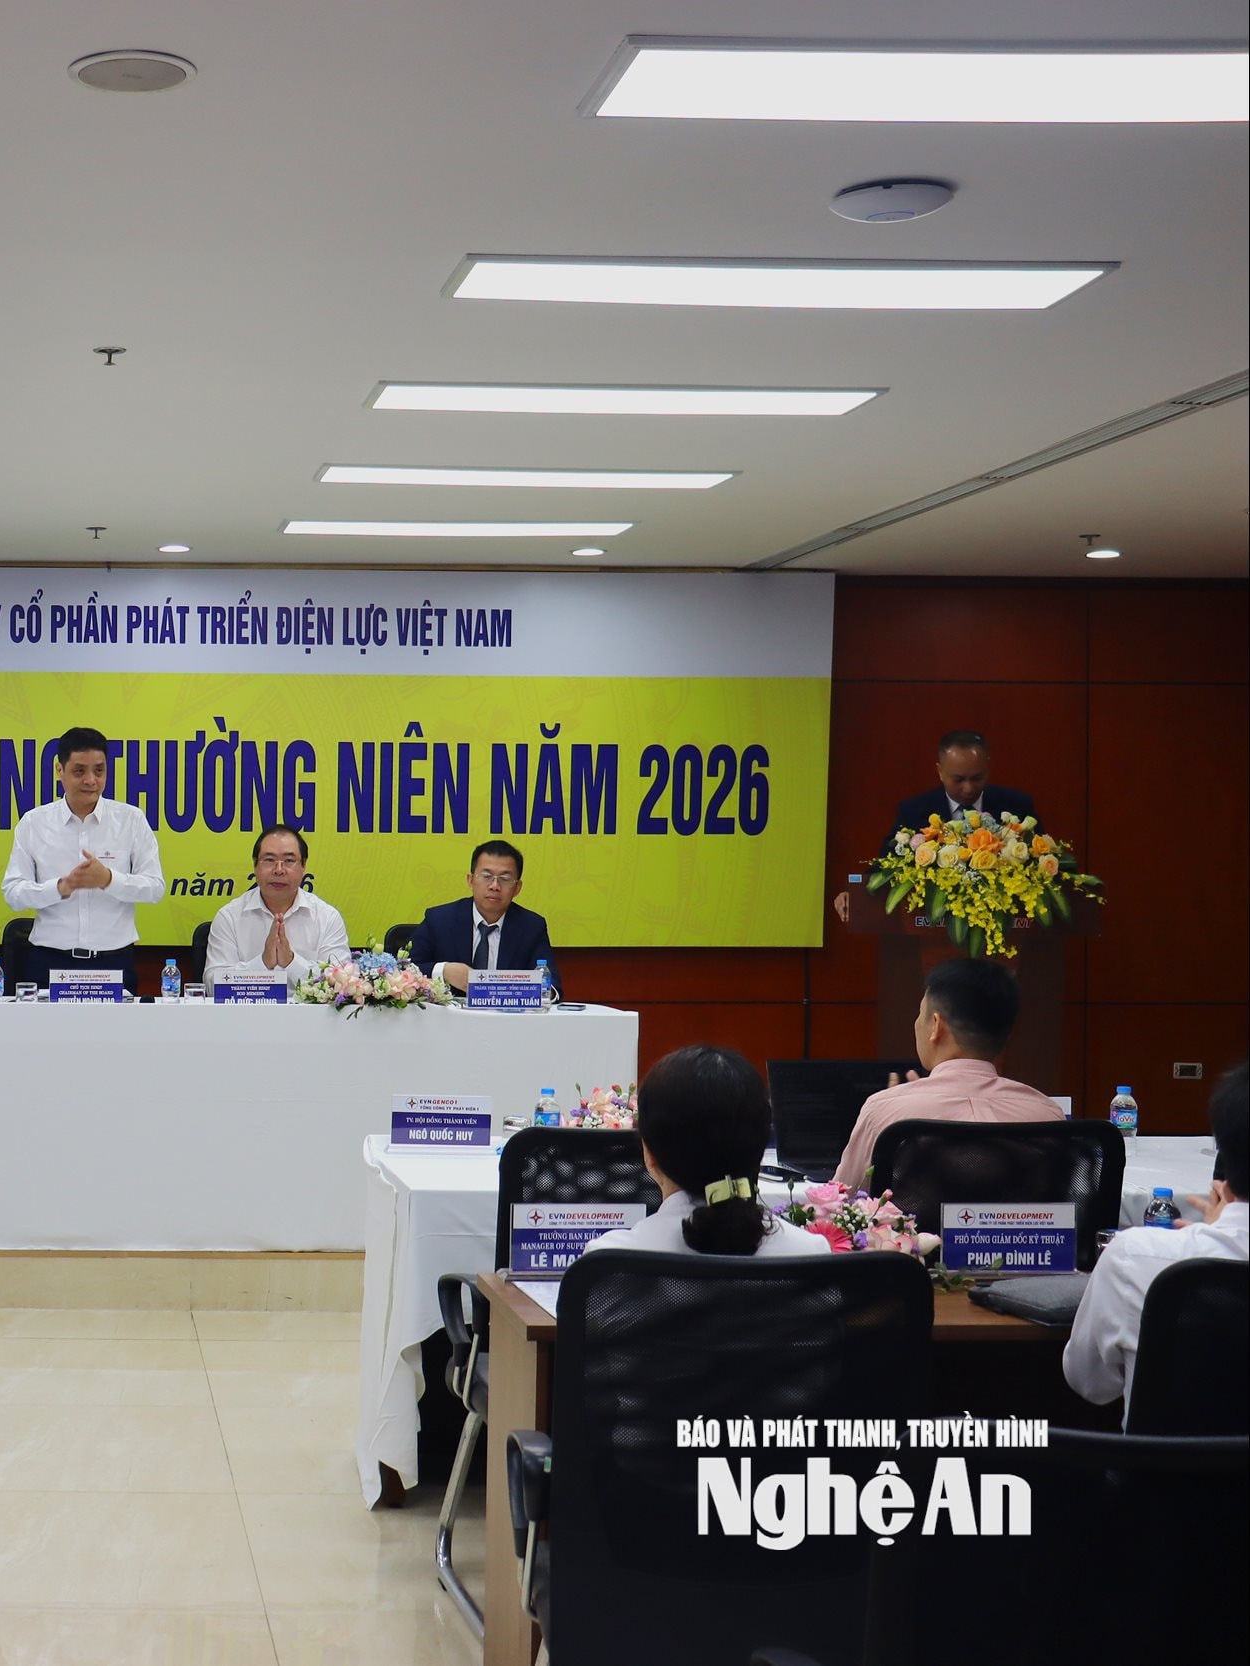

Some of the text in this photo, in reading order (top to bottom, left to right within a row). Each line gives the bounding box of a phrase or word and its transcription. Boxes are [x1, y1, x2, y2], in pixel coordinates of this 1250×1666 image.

[10, 588, 41, 643] CỔ
[50, 590, 116, 644] PHẦN
[126, 597, 189, 644] PHÁT
[197, 590, 268, 645] TRIỂN
[276, 600, 334, 654] ĐIỆN
[343, 603, 388, 655] LỰC
[397, 600, 447, 655] VIỆT
[456, 609, 512, 647] NAM
[105, 717, 318, 833] THƯỜNG
[338, 722, 470, 833] NIÊN
[491, 723, 618, 835] NĂM
[637, 744, 770, 836] 2026
[169, 872, 235, 897] năm
[247, 873, 315, 893] 26
[471, 996, 540, 1006] NGUYỄN ANH TUẤN
[414, 1116, 425, 1125] HỘI
[426, 1115, 443, 1125] ĐỒNG
[443, 1116, 463, 1125] THÀNH
[463, 1117, 478, 1125] VIÊN
[408, 1127, 474, 1142] NGÔ QUỐC HUY
[538, 1230, 568, 1241] TRƯỞNG
[569, 1232, 583, 1241] BAN
[954, 1232, 969, 1244] PHÓ
[970, 1230, 991, 1244] TỔNG
[992, 1232, 1011, 1244] GIÁM
[1012, 1231, 1028, 1244] ĐỐC
[1040, 1232, 1065, 1246] THUẬT
[520, 1242, 555, 1250] MANAGER
[555, 1242, 566, 1250] OF
[530, 1251, 548, 1268] LÊ
[968, 1250, 1052, 1268] PHẠM ĐÌNH LÊ
